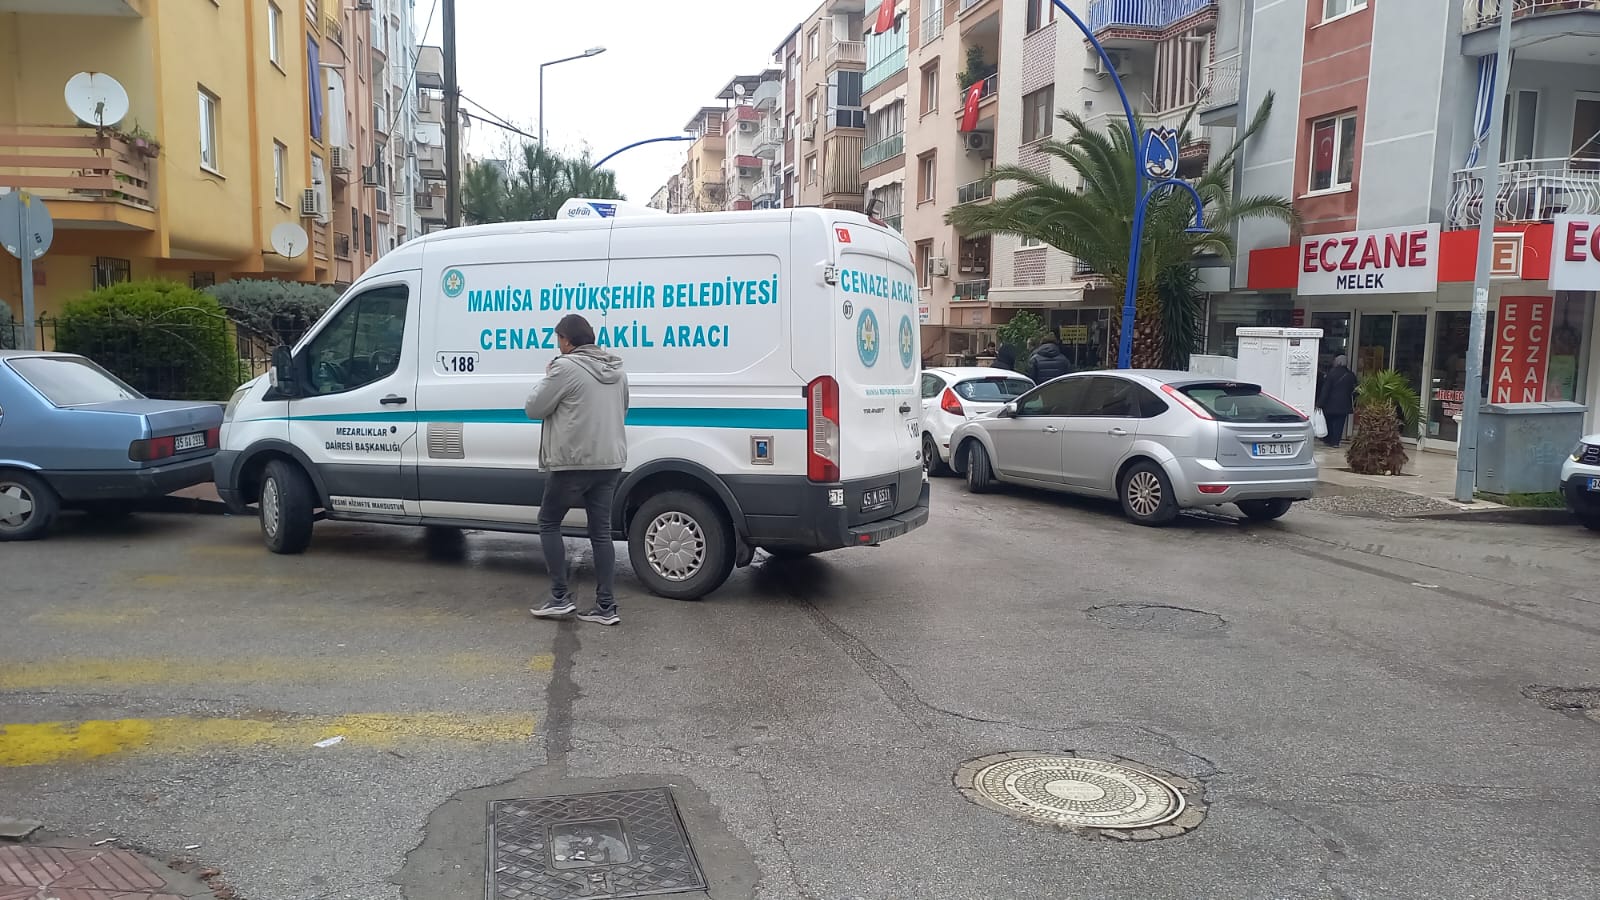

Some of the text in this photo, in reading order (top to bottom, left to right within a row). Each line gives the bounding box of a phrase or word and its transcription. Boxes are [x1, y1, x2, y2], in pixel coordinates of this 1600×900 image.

[1303, 230, 1428, 272] ECZANE
[841, 269, 889, 299] CENAZE
[1336, 273, 1384, 290] MELEK
[468, 273, 778, 316] MANİSA BÜYÜKŞEHİR BELEDİYESİ
[480, 320, 729, 350] CENAZ AKİL ARACI
[451, 356, 475, 372] 188
[336, 427, 388, 437] MEZARLIKLAR
[325, 440, 401, 453] DAİRESİ BAŞKANLIĞI
[1259, 445, 1266, 454] 16
[1269, 444, 1277, 454] ZZ
[864, 492, 871, 505] 45
